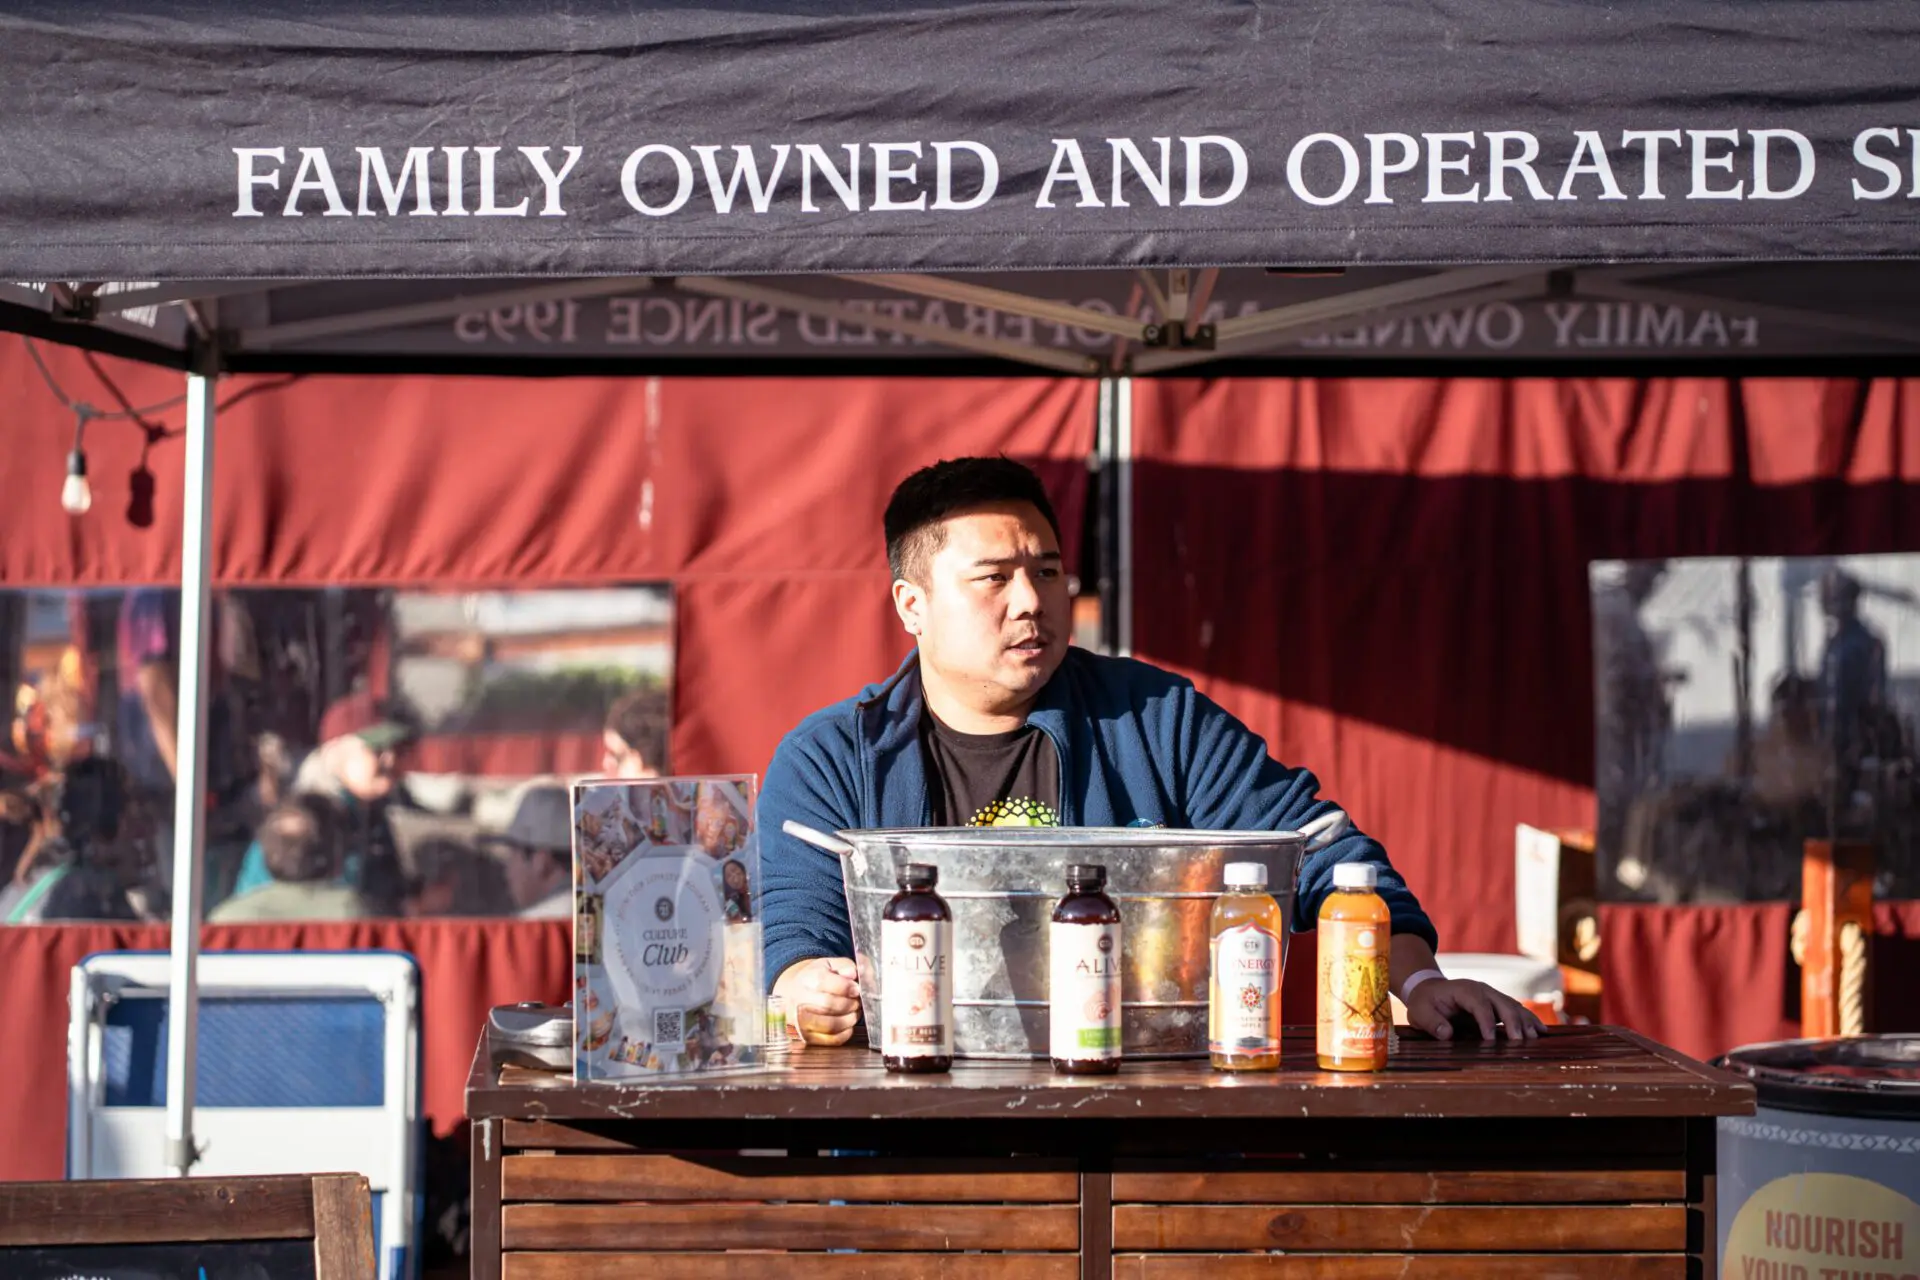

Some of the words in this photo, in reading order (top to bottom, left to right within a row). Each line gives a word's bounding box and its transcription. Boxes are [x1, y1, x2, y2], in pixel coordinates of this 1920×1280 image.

[231, 145, 584, 217] FAMILY
[620, 140, 999, 217] OWNED
[1034, 135, 1249, 210] AND
[1286, 128, 1816, 206] OPERATED
[642, 928, 688, 941] CULTURE
[643, 943, 689, 967] Club
[1076, 957, 1121, 974] ALIV
[1765, 1208, 1905, 1261] NOURISH
